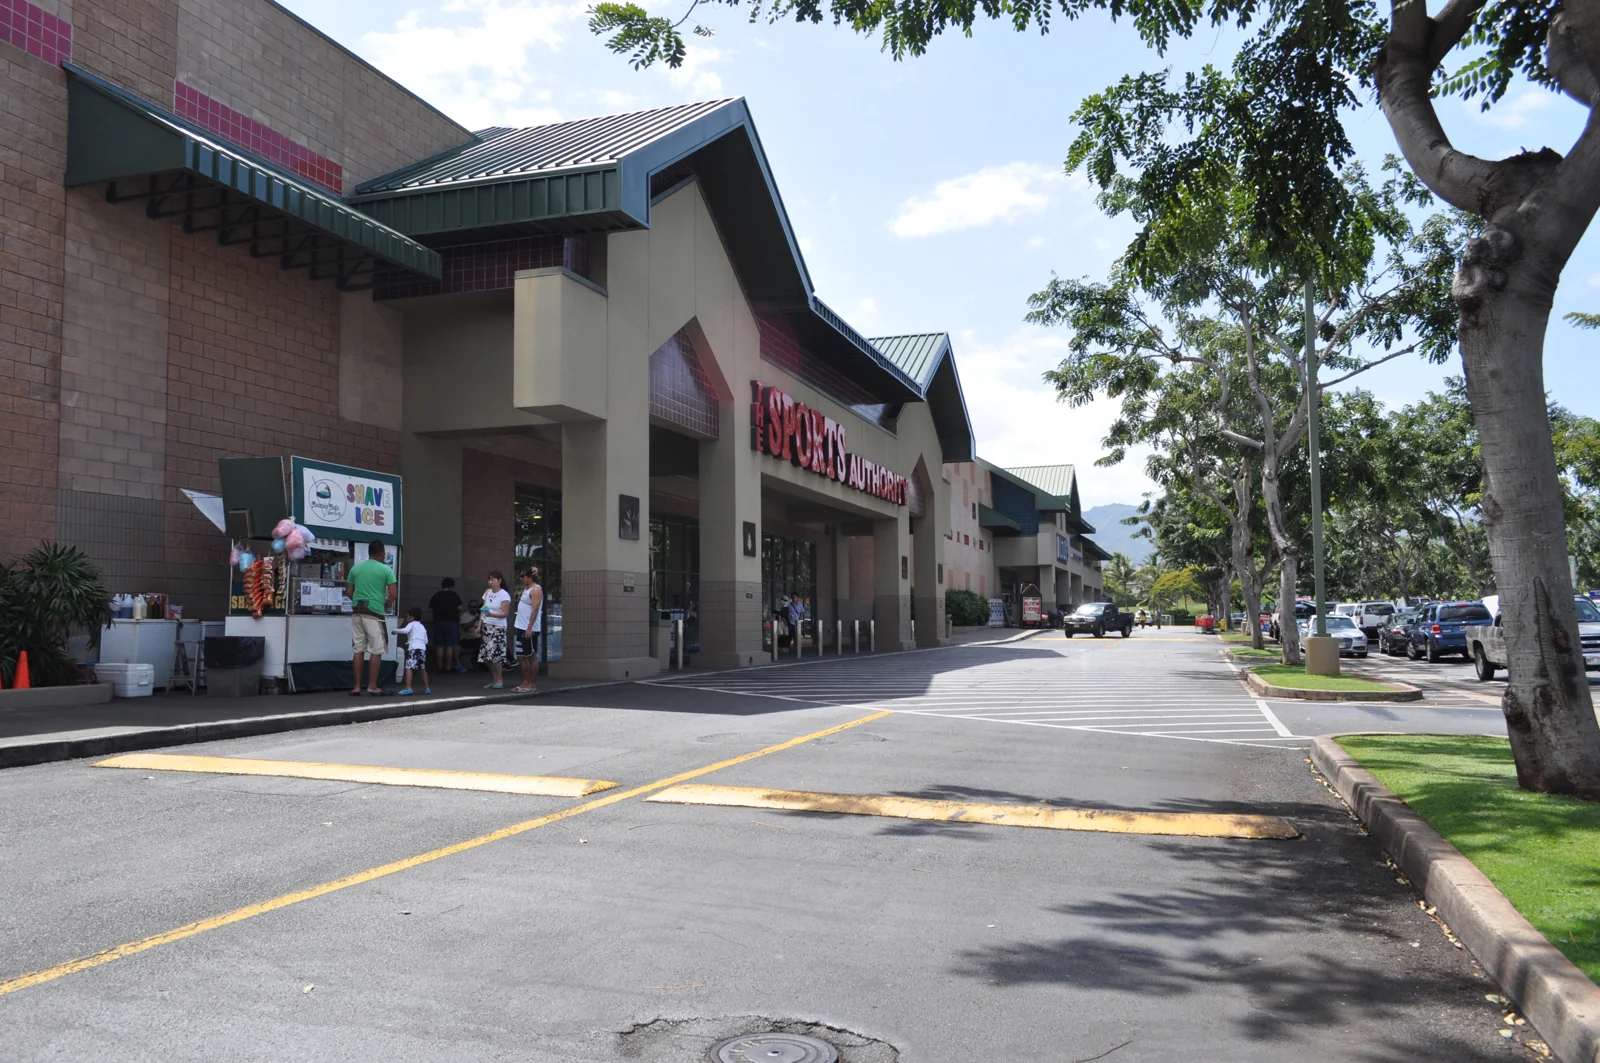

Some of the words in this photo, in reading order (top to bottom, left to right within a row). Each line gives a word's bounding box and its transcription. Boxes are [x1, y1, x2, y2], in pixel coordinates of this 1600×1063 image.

[750, 380, 764, 451] THE
[766, 387, 846, 483] SPORTS
[849, 453, 909, 506] AUTHORITY
[346, 483, 391, 508] SHAVE
[355, 506, 385, 526] ICE
